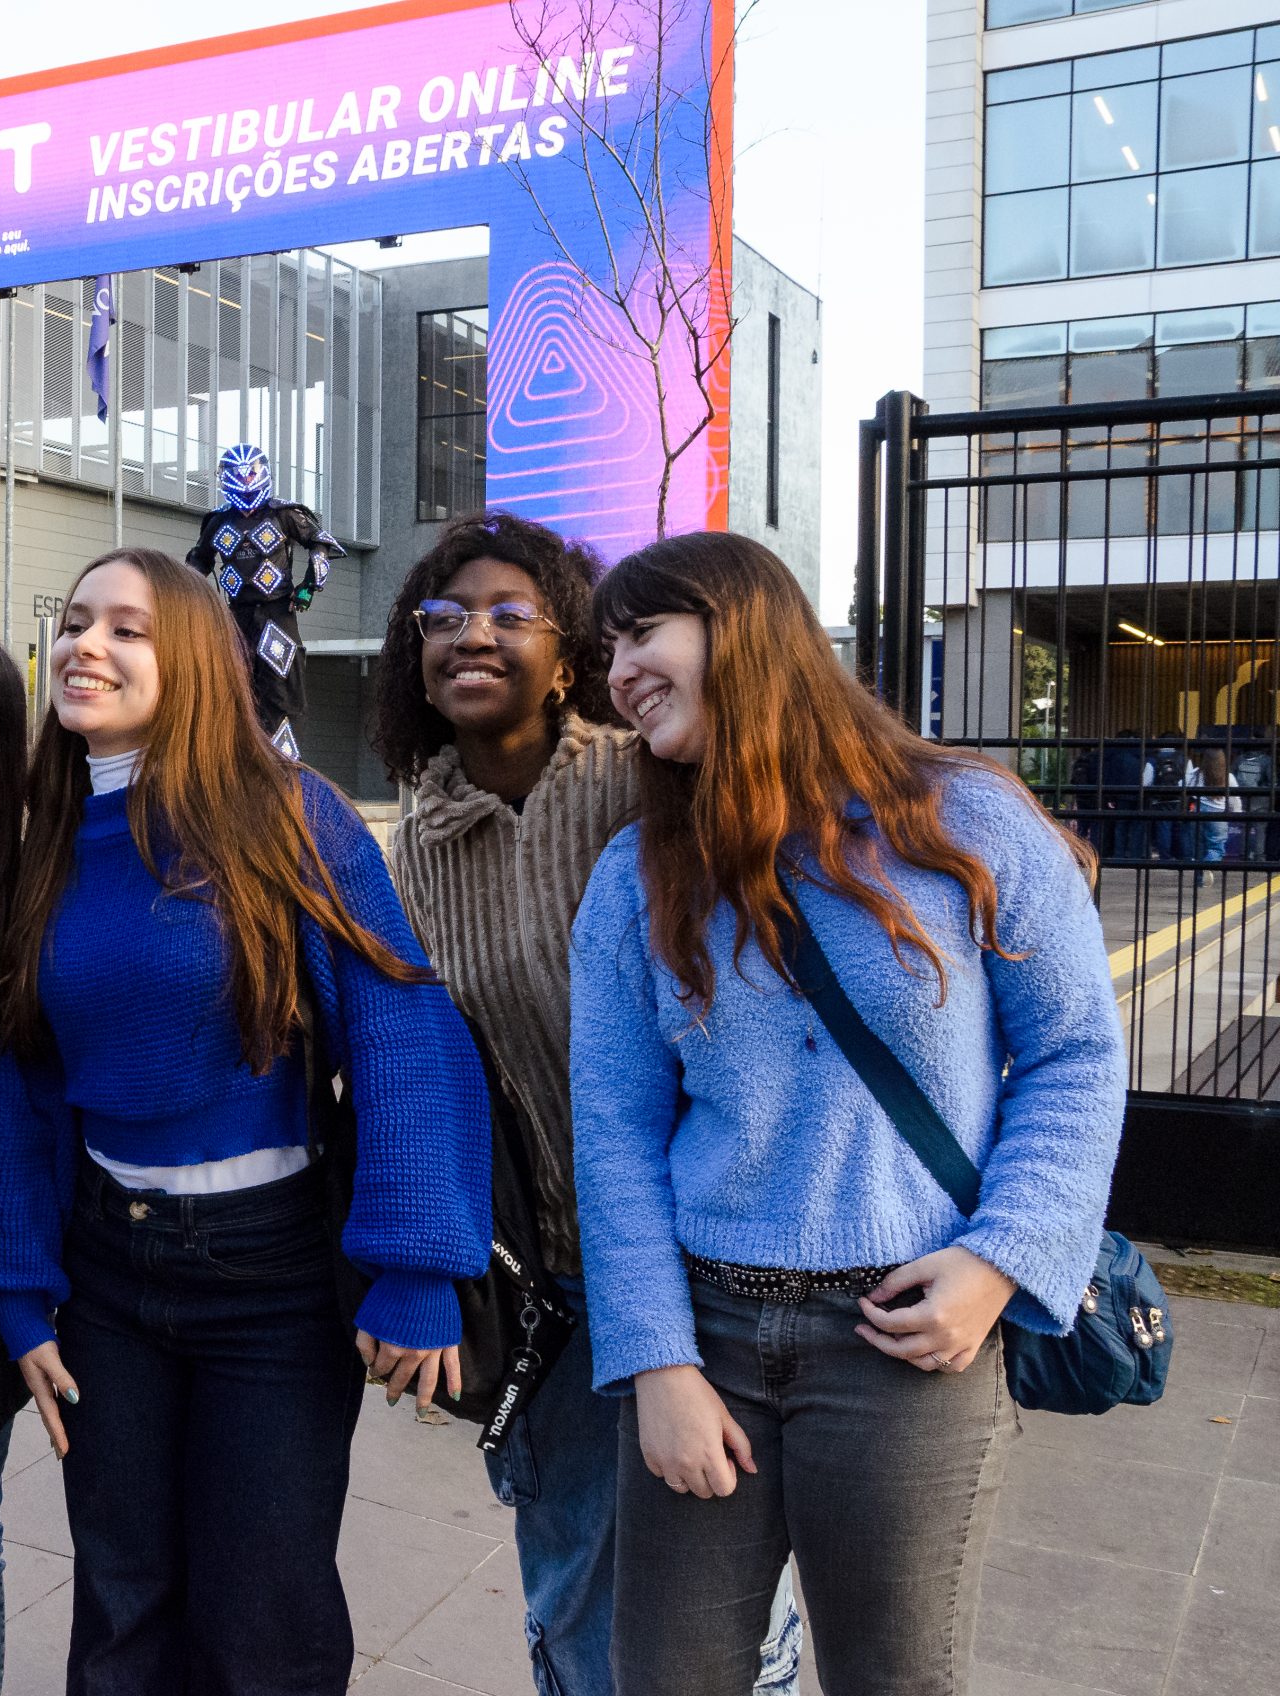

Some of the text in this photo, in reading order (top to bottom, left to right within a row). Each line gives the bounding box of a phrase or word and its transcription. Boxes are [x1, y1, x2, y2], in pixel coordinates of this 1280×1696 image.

[89, 45, 635, 177] VESTIBULAR ONLINE
[86, 115, 568, 224] INSCRIÇÕES ABERTAS
[2, 229, 22, 241] seu
[3, 239, 30, 256] aqui.
[488, 1384, 520, 1436] UP4YOU.
